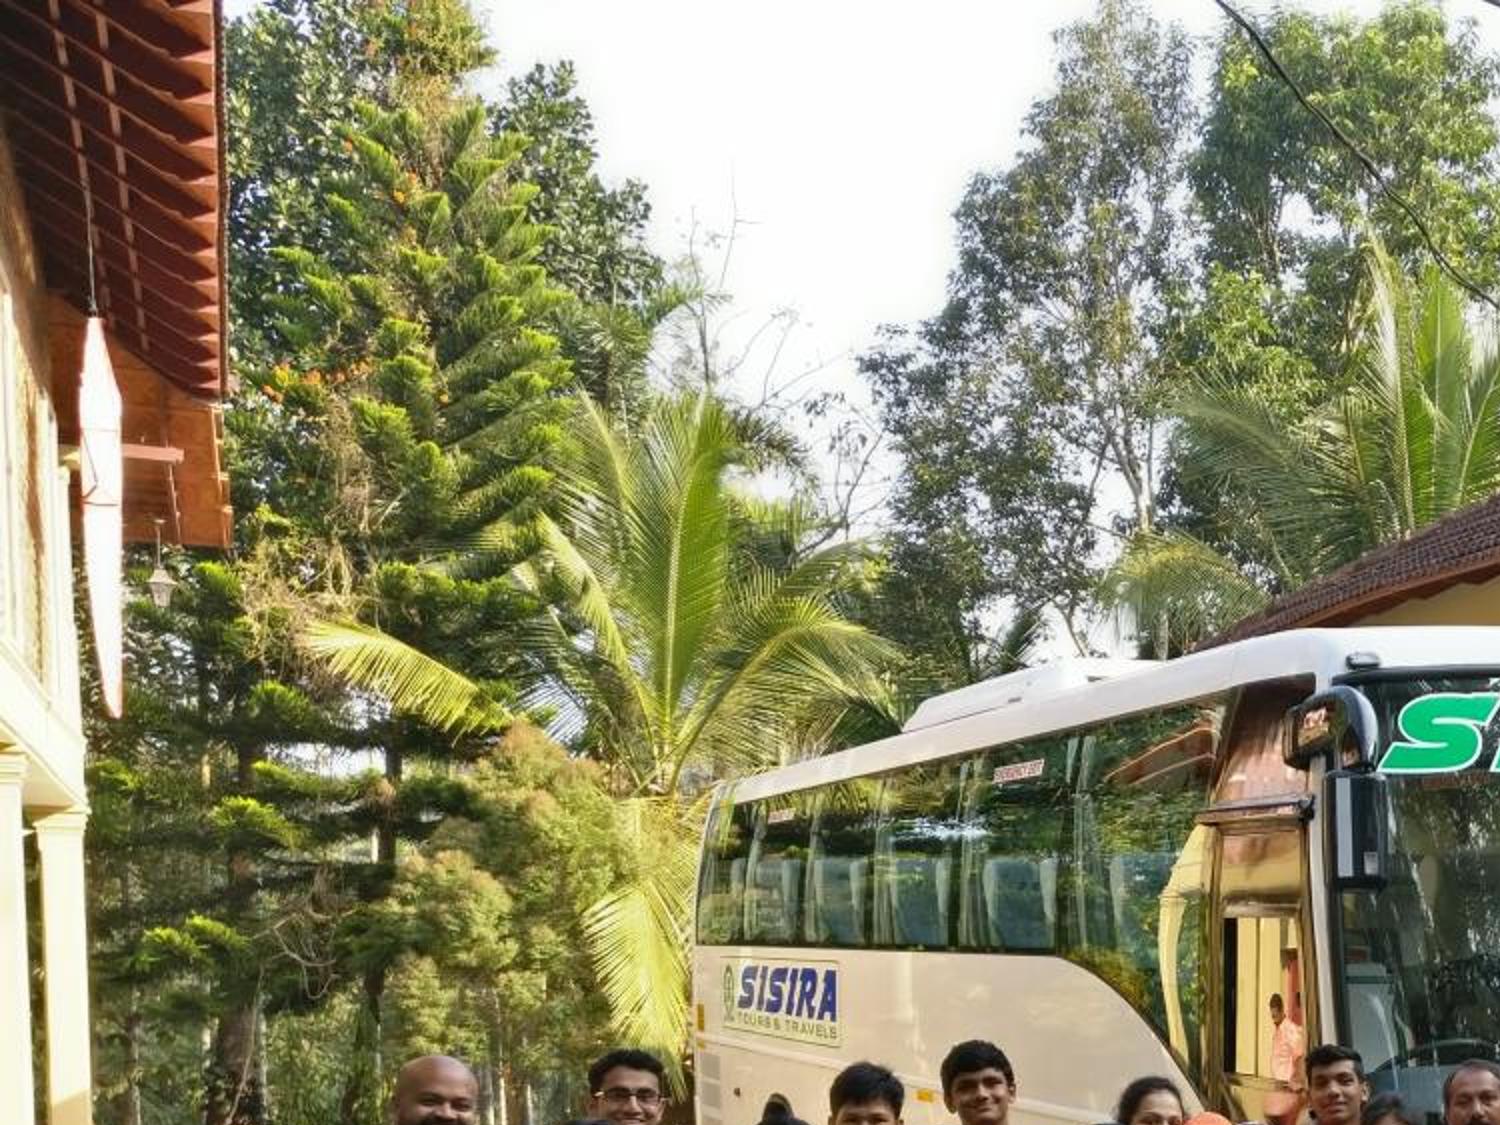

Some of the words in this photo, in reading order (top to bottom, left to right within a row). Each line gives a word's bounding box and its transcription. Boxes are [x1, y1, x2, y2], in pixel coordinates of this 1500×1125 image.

[737, 966, 837, 1023] SISIRA
[737, 1011, 771, 1029] TOURS
[784, 1019, 838, 1039] TRAVELS
